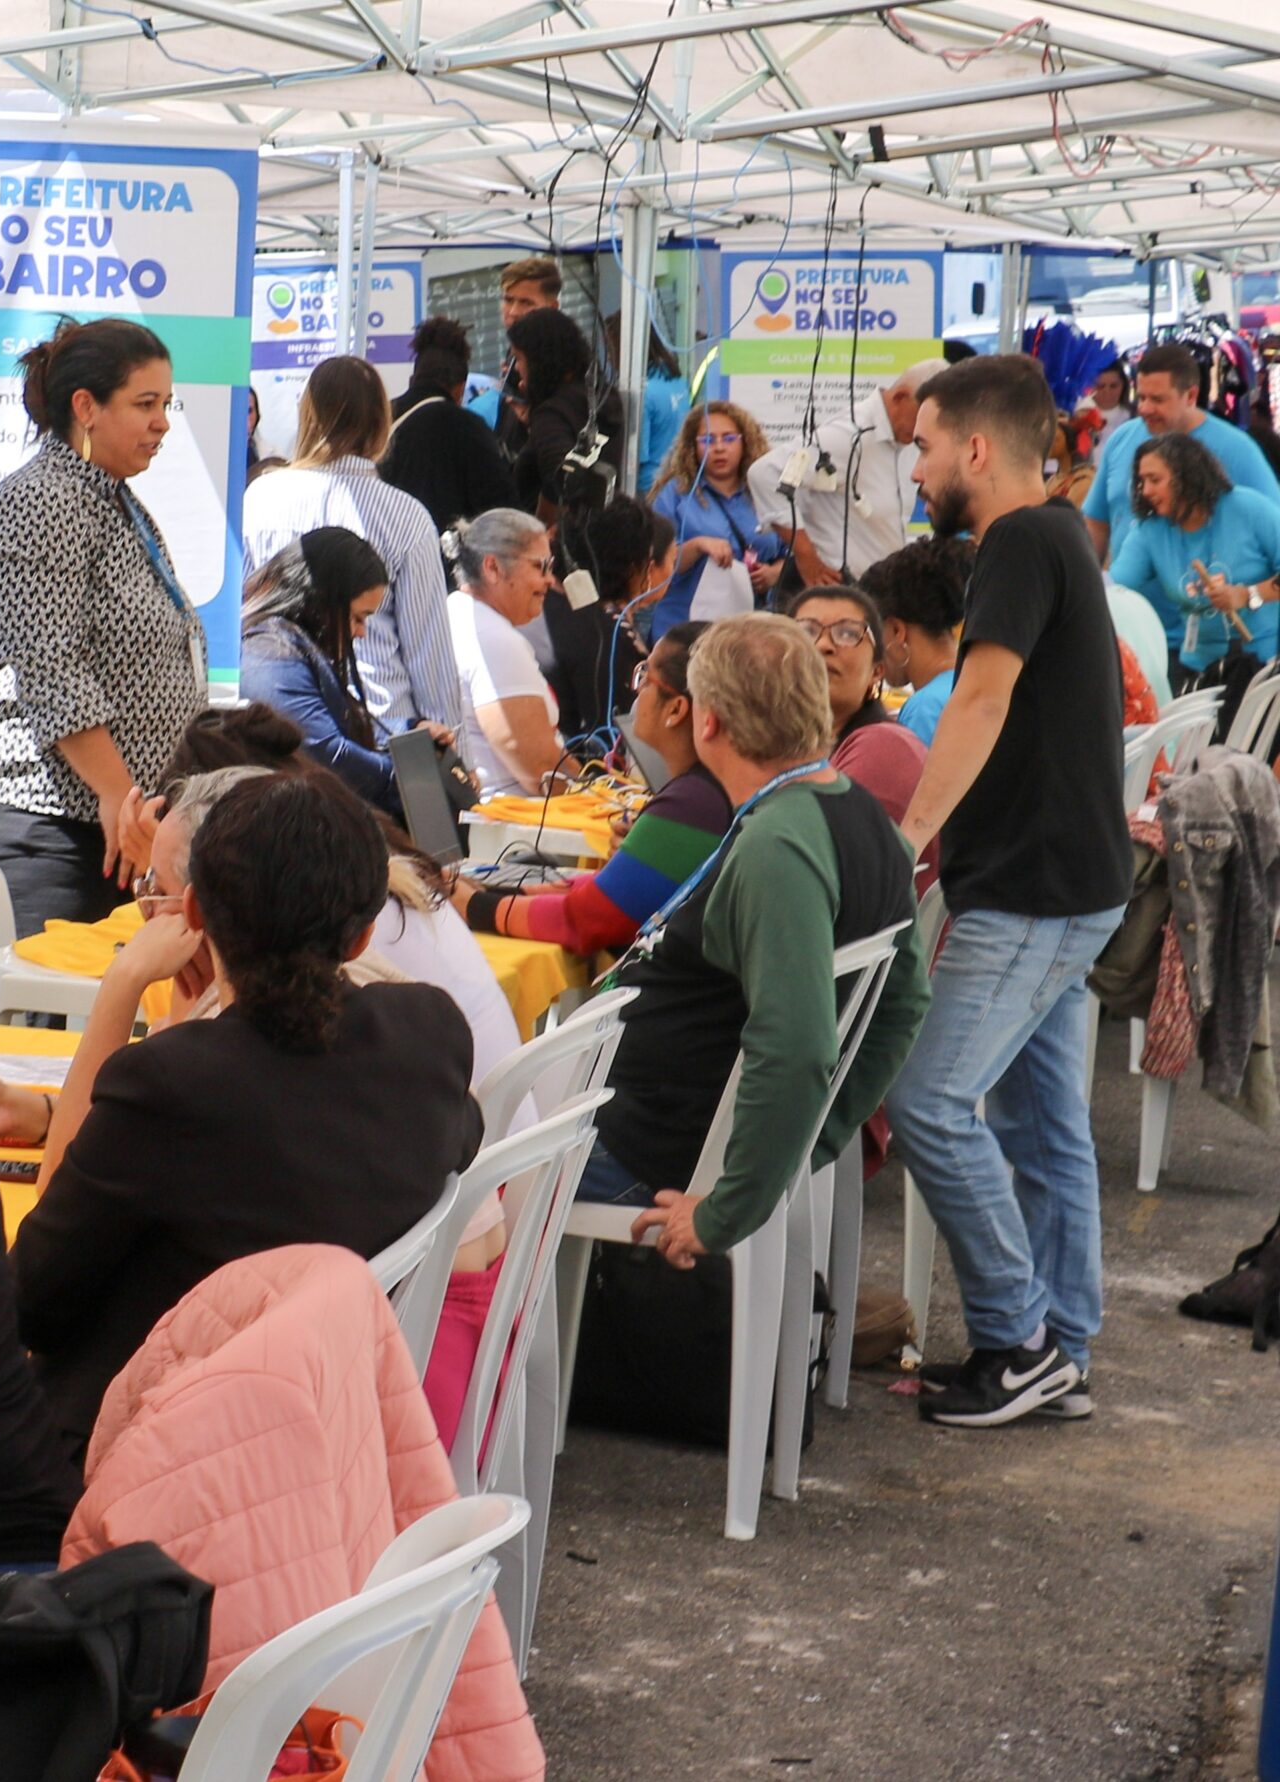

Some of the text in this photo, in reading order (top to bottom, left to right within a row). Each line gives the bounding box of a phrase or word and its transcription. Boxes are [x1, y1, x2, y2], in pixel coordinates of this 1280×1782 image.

[44, 216, 113, 248] SEU
[300, 296, 323, 310] NO
[795, 288, 823, 304] NO
[795, 309, 897, 330] BAIRRO
